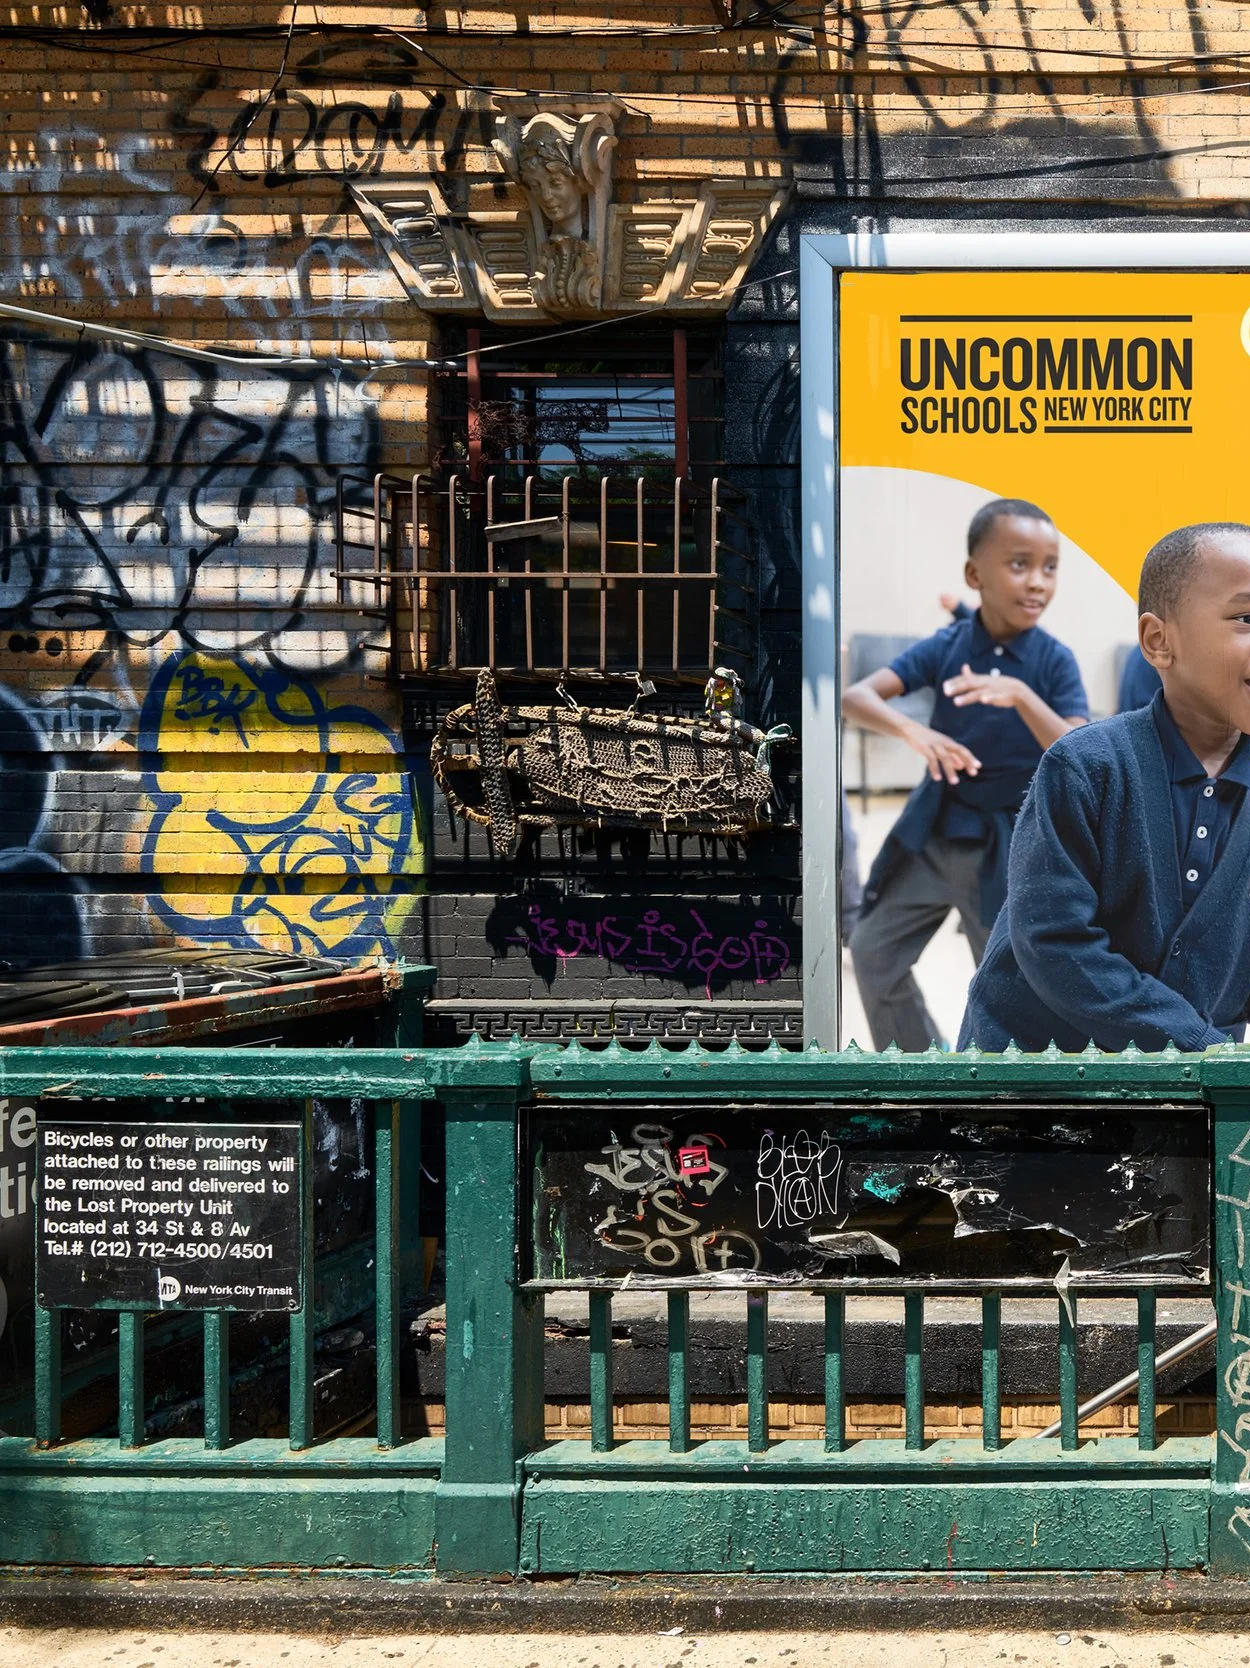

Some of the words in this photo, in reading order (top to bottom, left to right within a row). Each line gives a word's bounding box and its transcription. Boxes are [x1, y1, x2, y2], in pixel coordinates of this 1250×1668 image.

[901, 338, 1192, 391] UNCOMMON
[901, 397, 1037, 433] SCHOOLS
[1045, 397, 1087, 420] NEW
[1092, 397, 1143, 421] YORK
[1150, 397, 1191, 421] CITY
[45, 1131, 113, 1149] Bicycles
[121, 1136, 138, 1148] or
[145, 1133, 189, 1148] other
[195, 1135, 268, 1152] property
[45, 1154, 119, 1169] attached
[125, 1155, 143, 1170] to
[149, 1155, 197, 1170] these
[203, 1156, 261, 1174] railings
[268, 1157, 295, 1172] will
[45, 1175, 66, 1189] be
[73, 1177, 145, 1192] removed
[151, 1178, 182, 1192] and
[189, 1178, 265, 1193] delivered
[272, 1180, 289, 1193] to
[45, 1197, 71, 1212] the
[78, 1197, 115, 1212] Lost
[121, 1198, 193, 1217] Property
[200, 1200, 233, 1215] Unit
[44, 1218, 106, 1235] located
[112, 1220, 129, 1235] at
[136, 1220, 158, 1235] 34
[165, 1220, 184, 1236] St
[191, 1221, 203, 1236] &
[211, 1221, 224, 1236] 8
[230, 1222, 251, 1237] Av
[44, 1240, 83, 1256] Tel.#
[91, 1240, 131, 1258] (212)
[137, 1242, 274, 1260] 712-4500/4501
[185, 1284, 206, 1295] New
[209, 1285, 233, 1295] York
[234, 1285, 256, 1297] City
[257, 1286, 293, 1296] Transit
